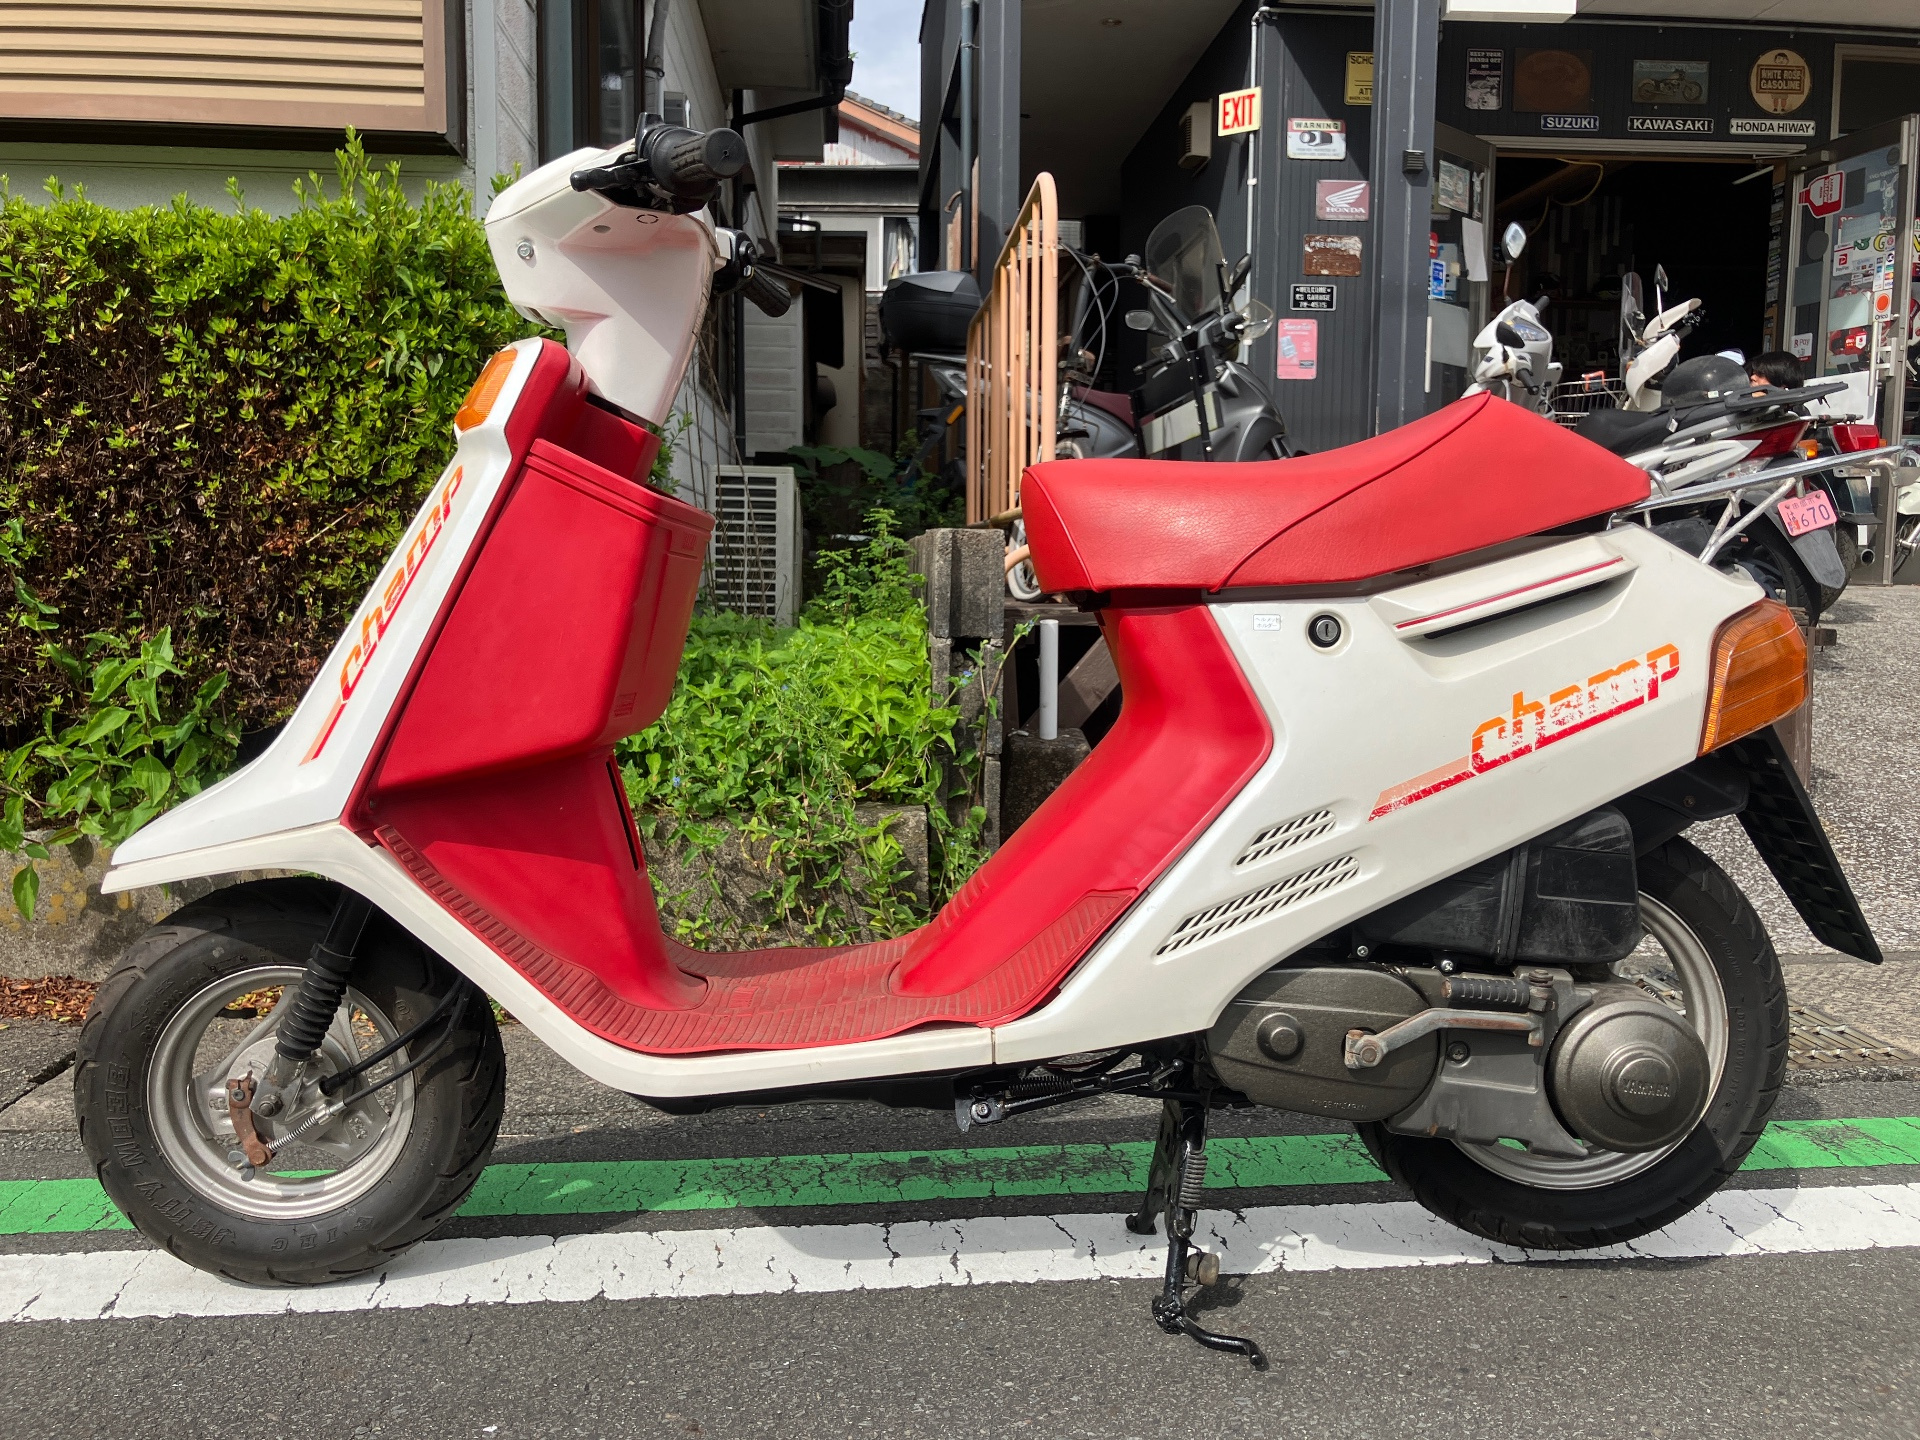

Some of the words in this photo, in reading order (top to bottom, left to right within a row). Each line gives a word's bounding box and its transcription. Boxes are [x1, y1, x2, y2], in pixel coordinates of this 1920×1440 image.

[1761, 69, 1782, 79] WHITE
[1783, 69, 1802, 79] ROSE
[1760, 80, 1801, 90] GASOLINE
[1222, 93, 1256, 131] EXIT
[1294, 121, 1341, 130] WARNING
[1546, 117, 1595, 128] SUZUKI
[1633, 118, 1709, 131] KAWASAKI
[1735, 121, 1775, 132] HONDA
[1777, 122, 1812, 133] HIWAY
[1874, 313, 1889, 321] Orico
[1800, 503, 1831, 528] 670
[1470, 641, 1681, 776] champ
[1622, 1077, 1671, 1098] YAMAHA
